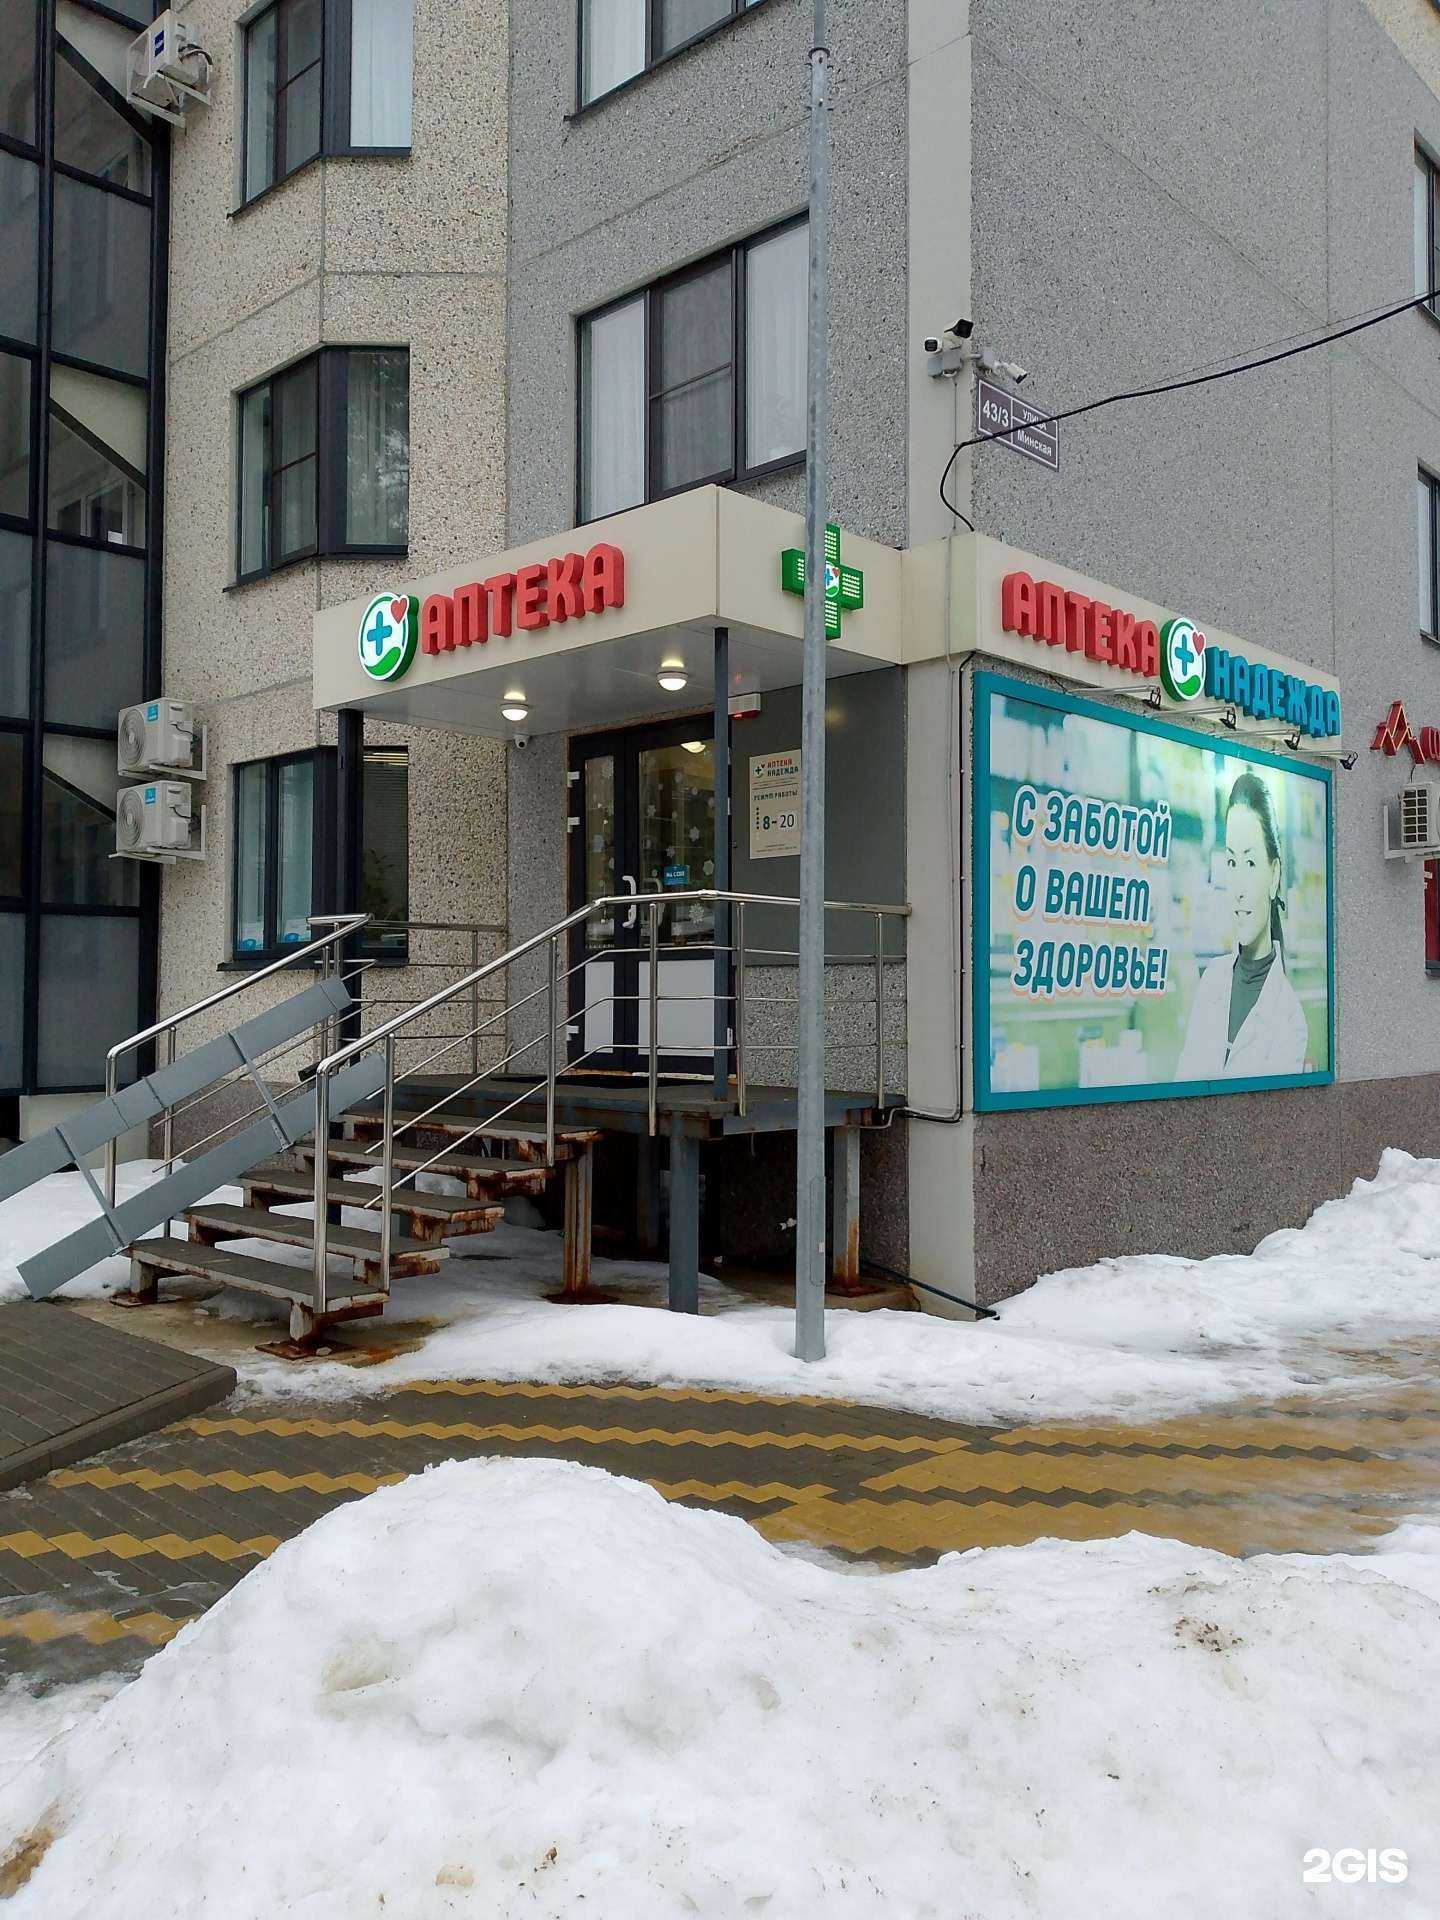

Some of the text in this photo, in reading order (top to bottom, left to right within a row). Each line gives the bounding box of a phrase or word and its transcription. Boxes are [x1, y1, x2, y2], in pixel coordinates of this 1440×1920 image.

[983, 400, 1009, 427] 43/3
[1017, 429, 1052, 457] Минская
[422, 543, 625, 656] АПТЕКА
[1002, 571, 1161, 677] АПТЕКА
[1204, 646, 1341, 738] НАДЕЖДА
[1015, 790, 1169, 858] С ЗАБОТОЙ
[1015, 865, 1150, 922] О ВАШЕМ
[1014, 940, 1168, 993] ЗДОРОВЬЕ!
